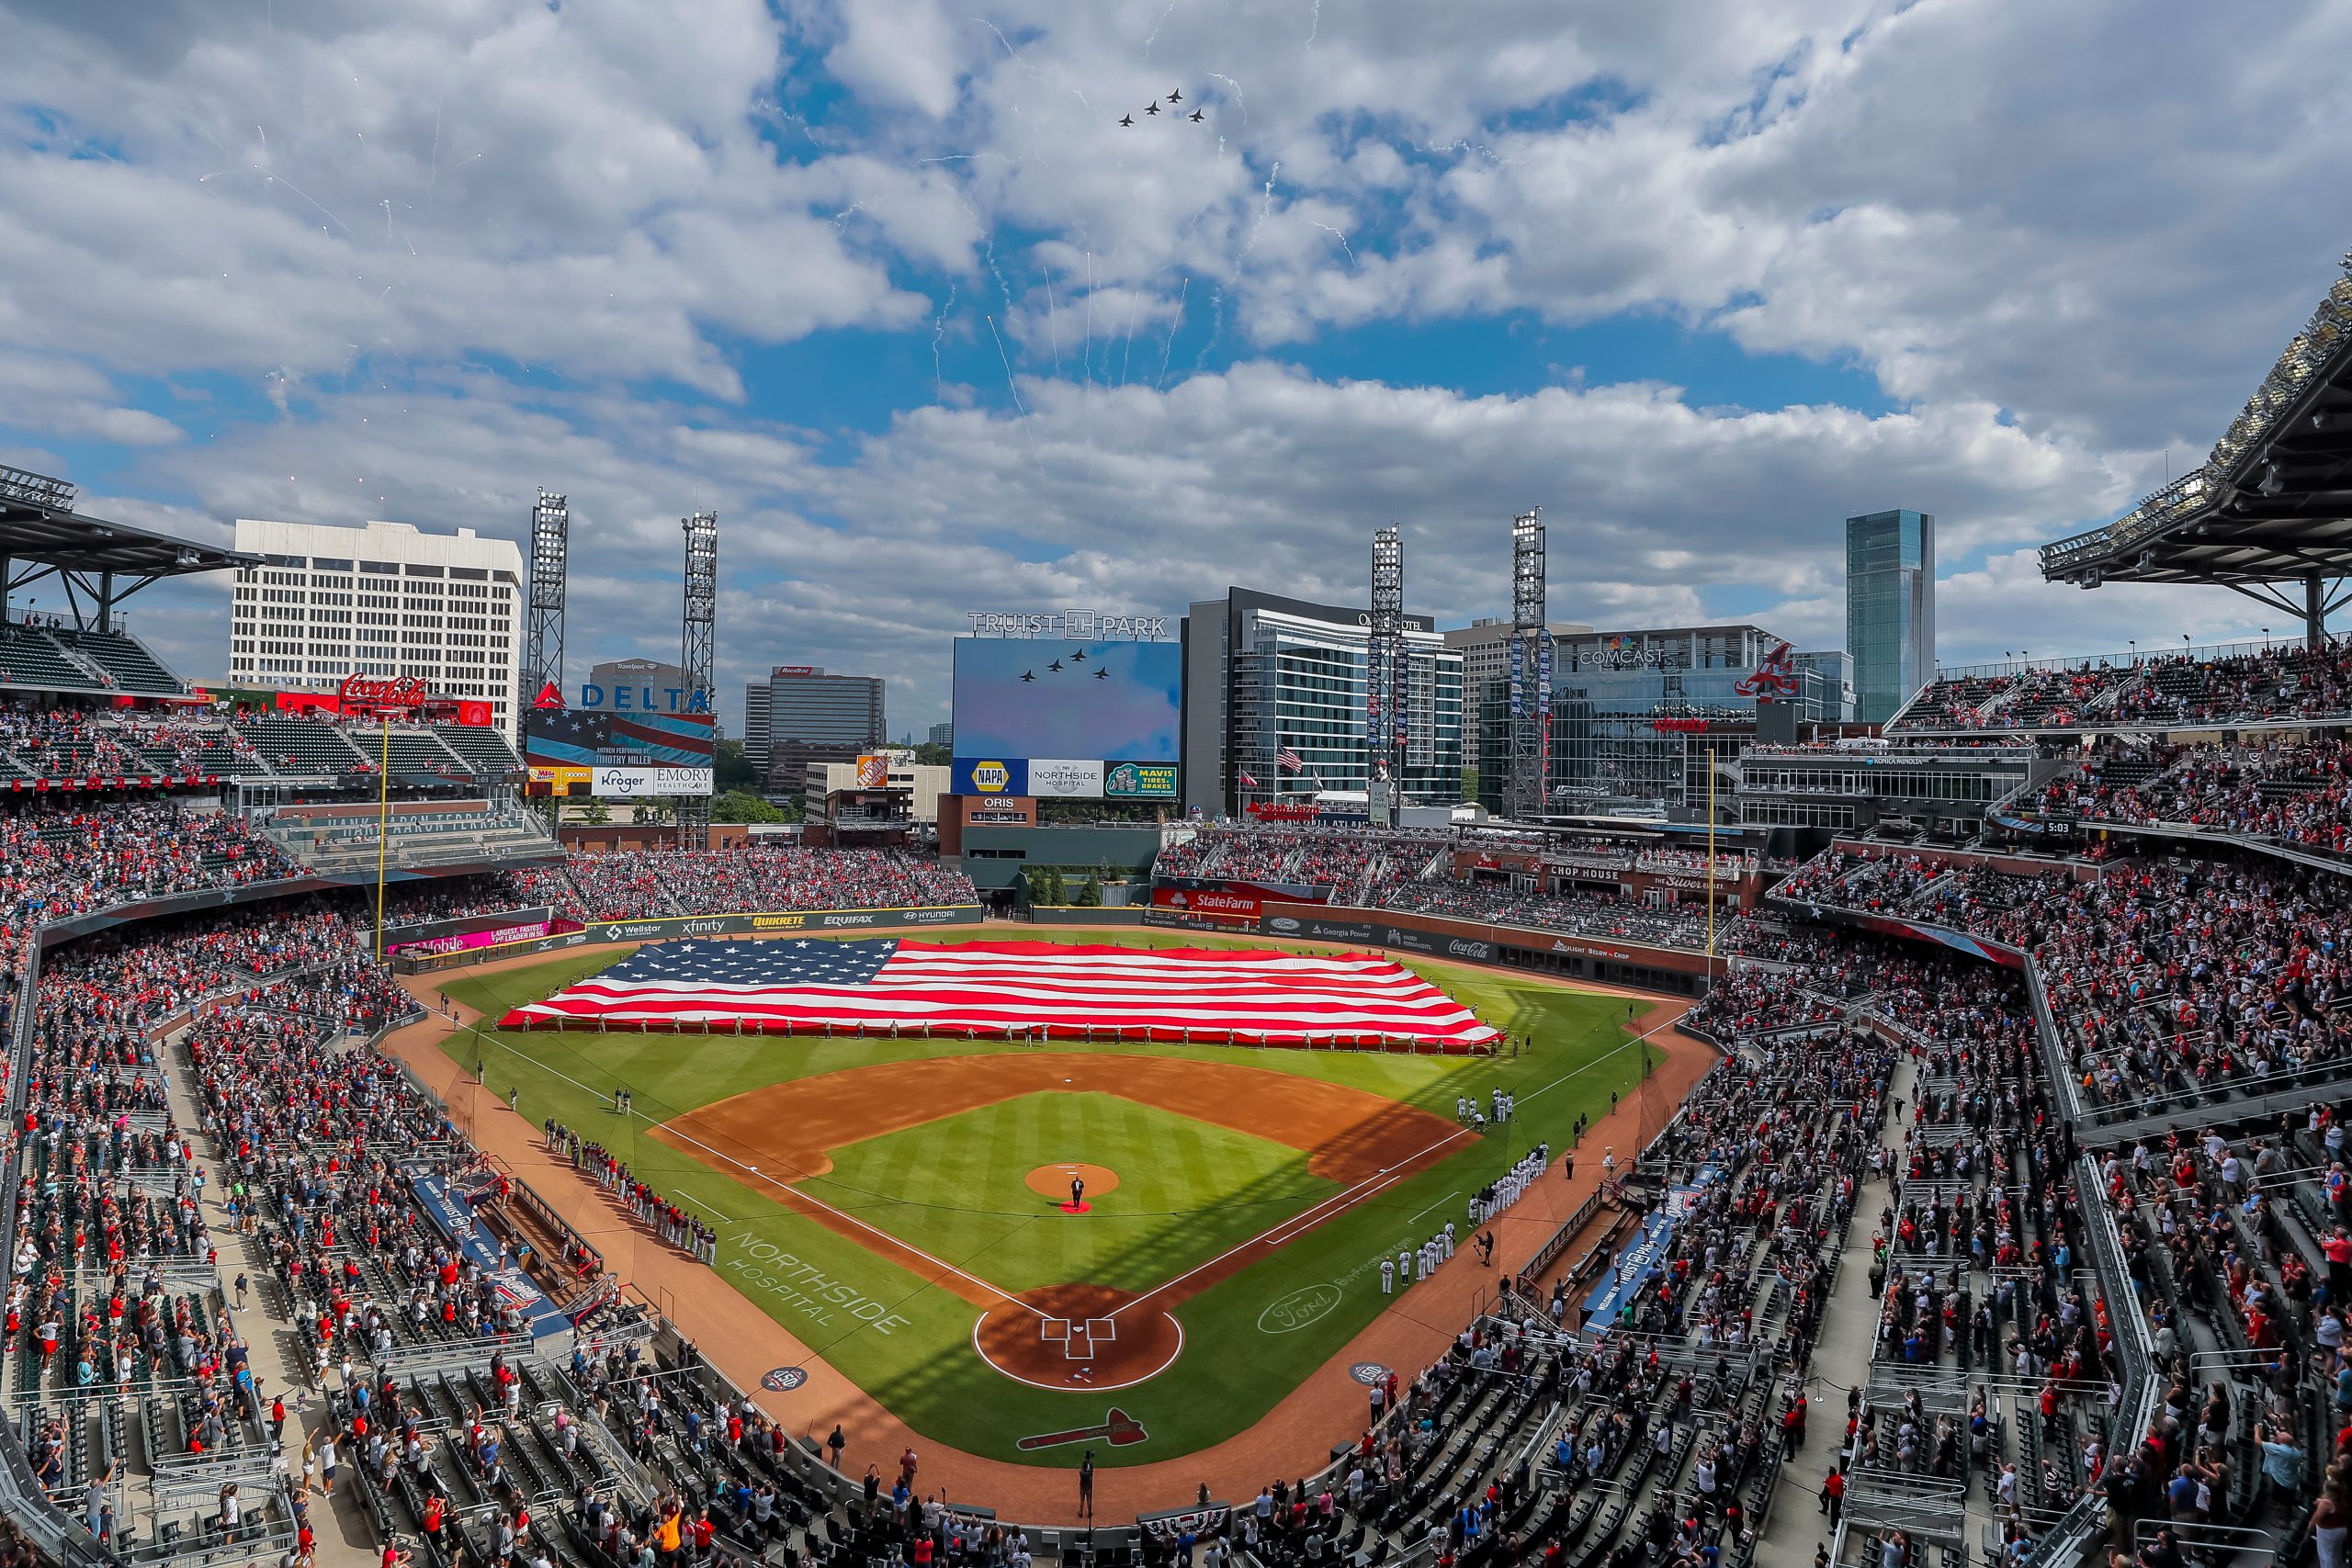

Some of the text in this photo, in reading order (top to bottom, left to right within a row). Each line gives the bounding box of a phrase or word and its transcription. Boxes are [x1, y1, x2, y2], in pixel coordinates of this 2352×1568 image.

[967, 612, 1169, 637] TRUIST PARK
[1579, 649, 1665, 665] COMCAST
[616, 662, 645, 671] Travelport
[341, 671, 430, 705] Coca-Cola
[581, 683, 710, 711] DELTA
[595, 754, 651, 764] TIMOTHY MILLER
[860, 759, 874, 772] THE
[657, 769, 710, 782] EMORY
[856, 757, 888, 786] HOME
[978, 770, 1003, 784] NAPA
[1035, 771, 1098, 780] NORTHSIDE
[12, 778, 21, 792] 6
[36, 778, 49, 792] 10
[229, 774, 241, 784] 42
[601, 769, 645, 794] Kroger
[984, 797, 1014, 807] ORIS
[2048, 822, 2069, 833] 5:03
[1500, 862, 1524, 871] LIGHT
[1551, 865, 1619, 879] CHOP HOUSE
[1666, 874, 1702, 888] Silver
[752, 916, 805, 926] QUIKRETE
[823, 915, 874, 927] EQUIFAX
[918, 910, 956, 919] HYUNDAI
[625, 924, 662, 933] Wellstar
[682, 920, 726, 936] xfinity
[1275, 919, 1294, 929] Ford
[504, 932, 527, 942] LEADER
[1323, 928, 1371, 939] Georgia Power
[1588, 948, 1608, 956] BELOW
[728, 1232, 911, 1335] NORTHSIDE
[726, 1258, 837, 1326] HOSPITAL
[1598, 1291, 1617, 1311] WELCOME
[1272, 1292, 1330, 1326] Ford
[1012, 1540, 1019, 1548] 7
